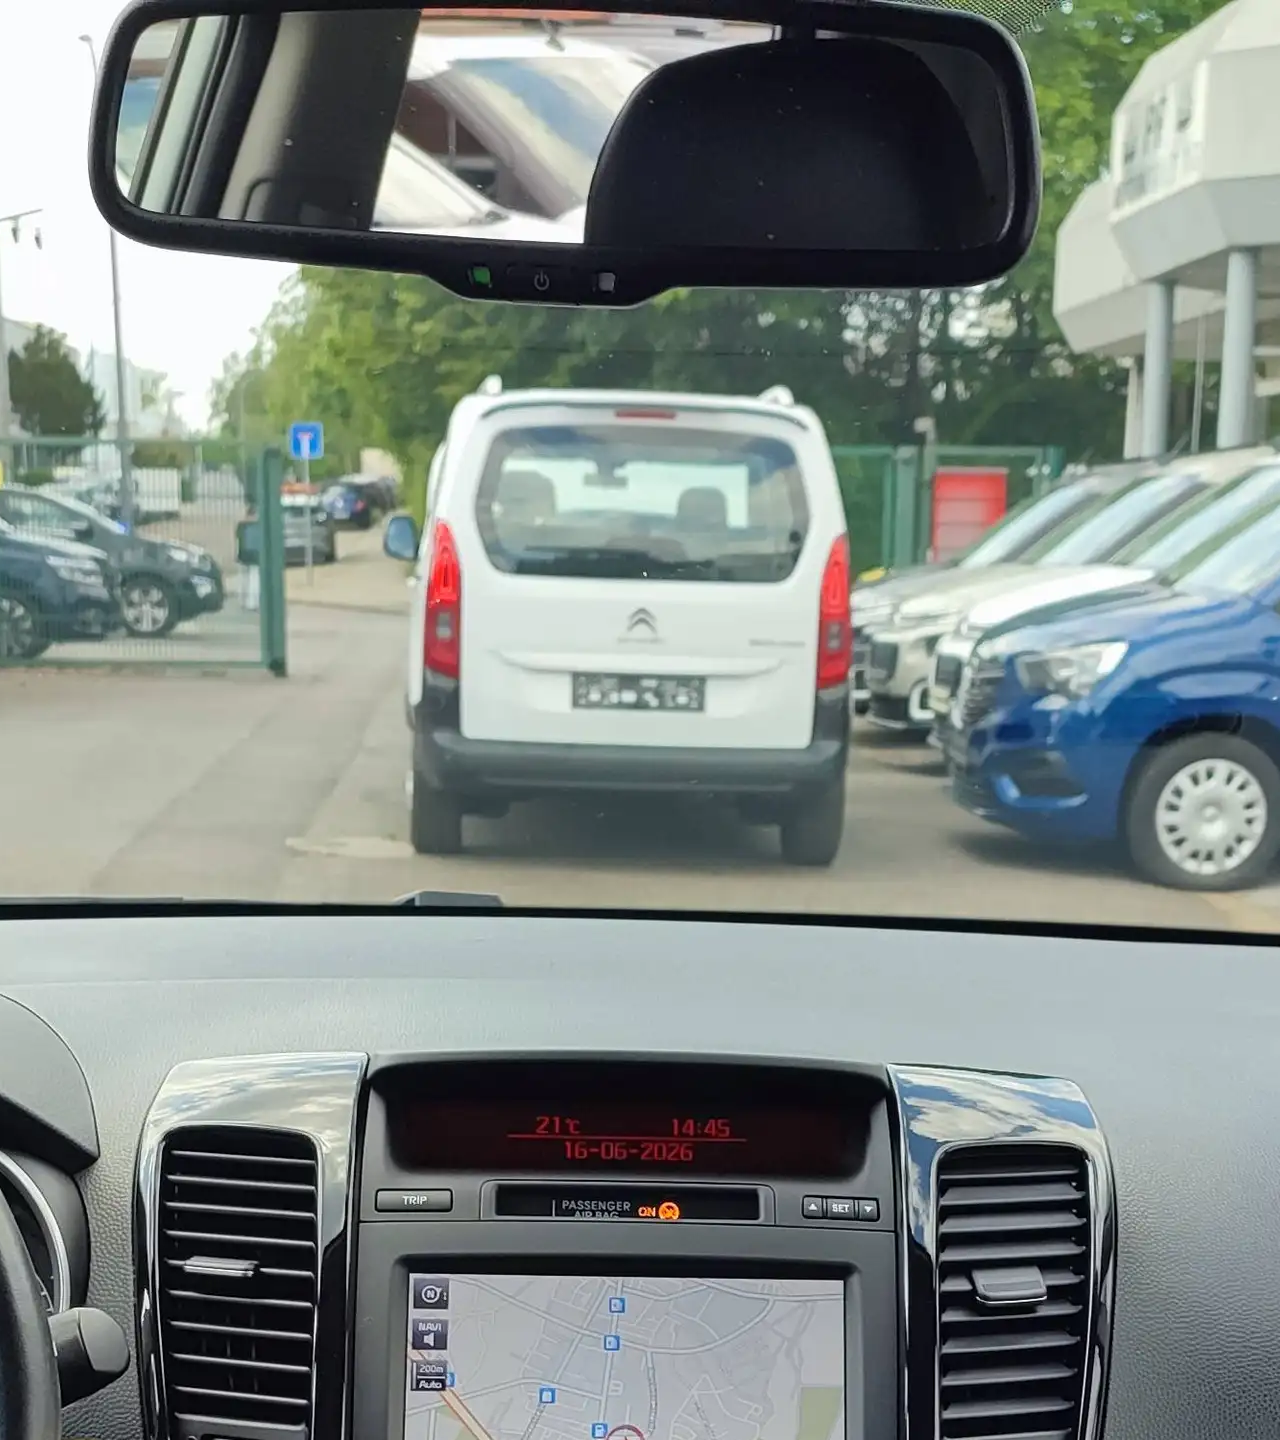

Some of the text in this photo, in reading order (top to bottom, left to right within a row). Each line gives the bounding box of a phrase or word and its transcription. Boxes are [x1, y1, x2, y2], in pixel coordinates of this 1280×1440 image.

[671, 1118, 730, 1137] 14:45
[564, 1140, 694, 1162] 16-06-2026
[402, 1195, 428, 1206] TRIP
[561, 1199, 631, 1212] PASSENGER
[638, 1206, 656, 1218] ON
[831, 1203, 850, 1214] SET
[418, 1322, 442, 1332] NAVI
[419, 1364, 444, 1373] 200m
[418, 1380, 442, 1389] Auto
